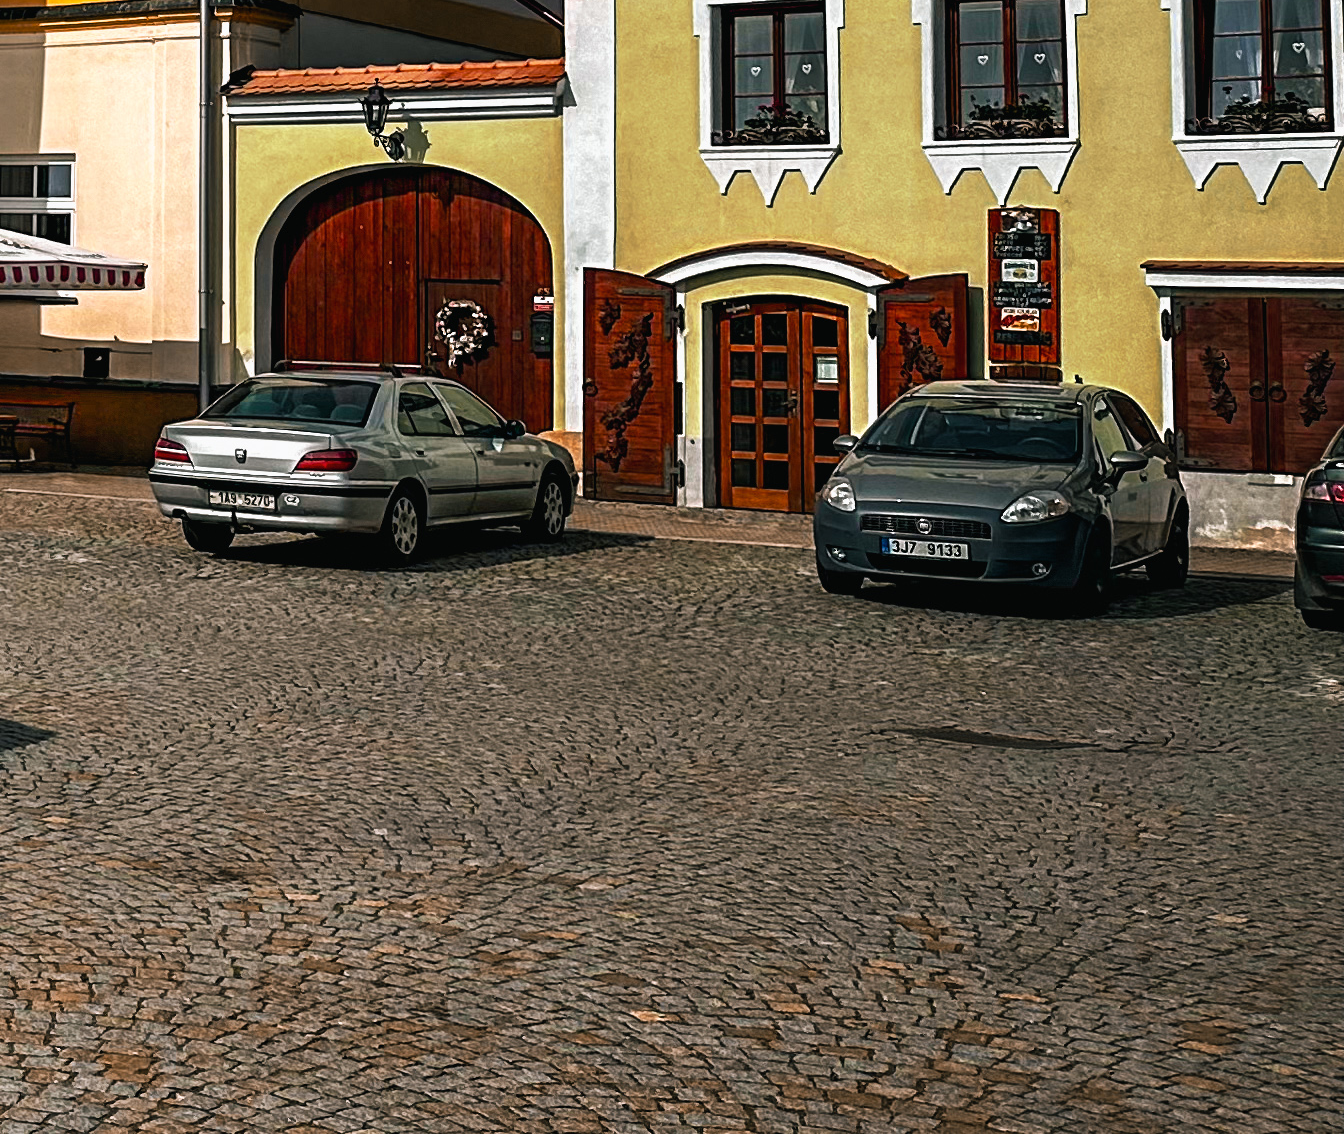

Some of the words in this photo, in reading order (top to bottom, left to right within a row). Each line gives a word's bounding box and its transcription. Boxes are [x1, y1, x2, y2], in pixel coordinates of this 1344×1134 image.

[219, 491, 237, 504] 1A9
[244, 494, 270, 507] 5270
[891, 540, 917, 554] 3J7
[927, 542, 962, 557] 9133
